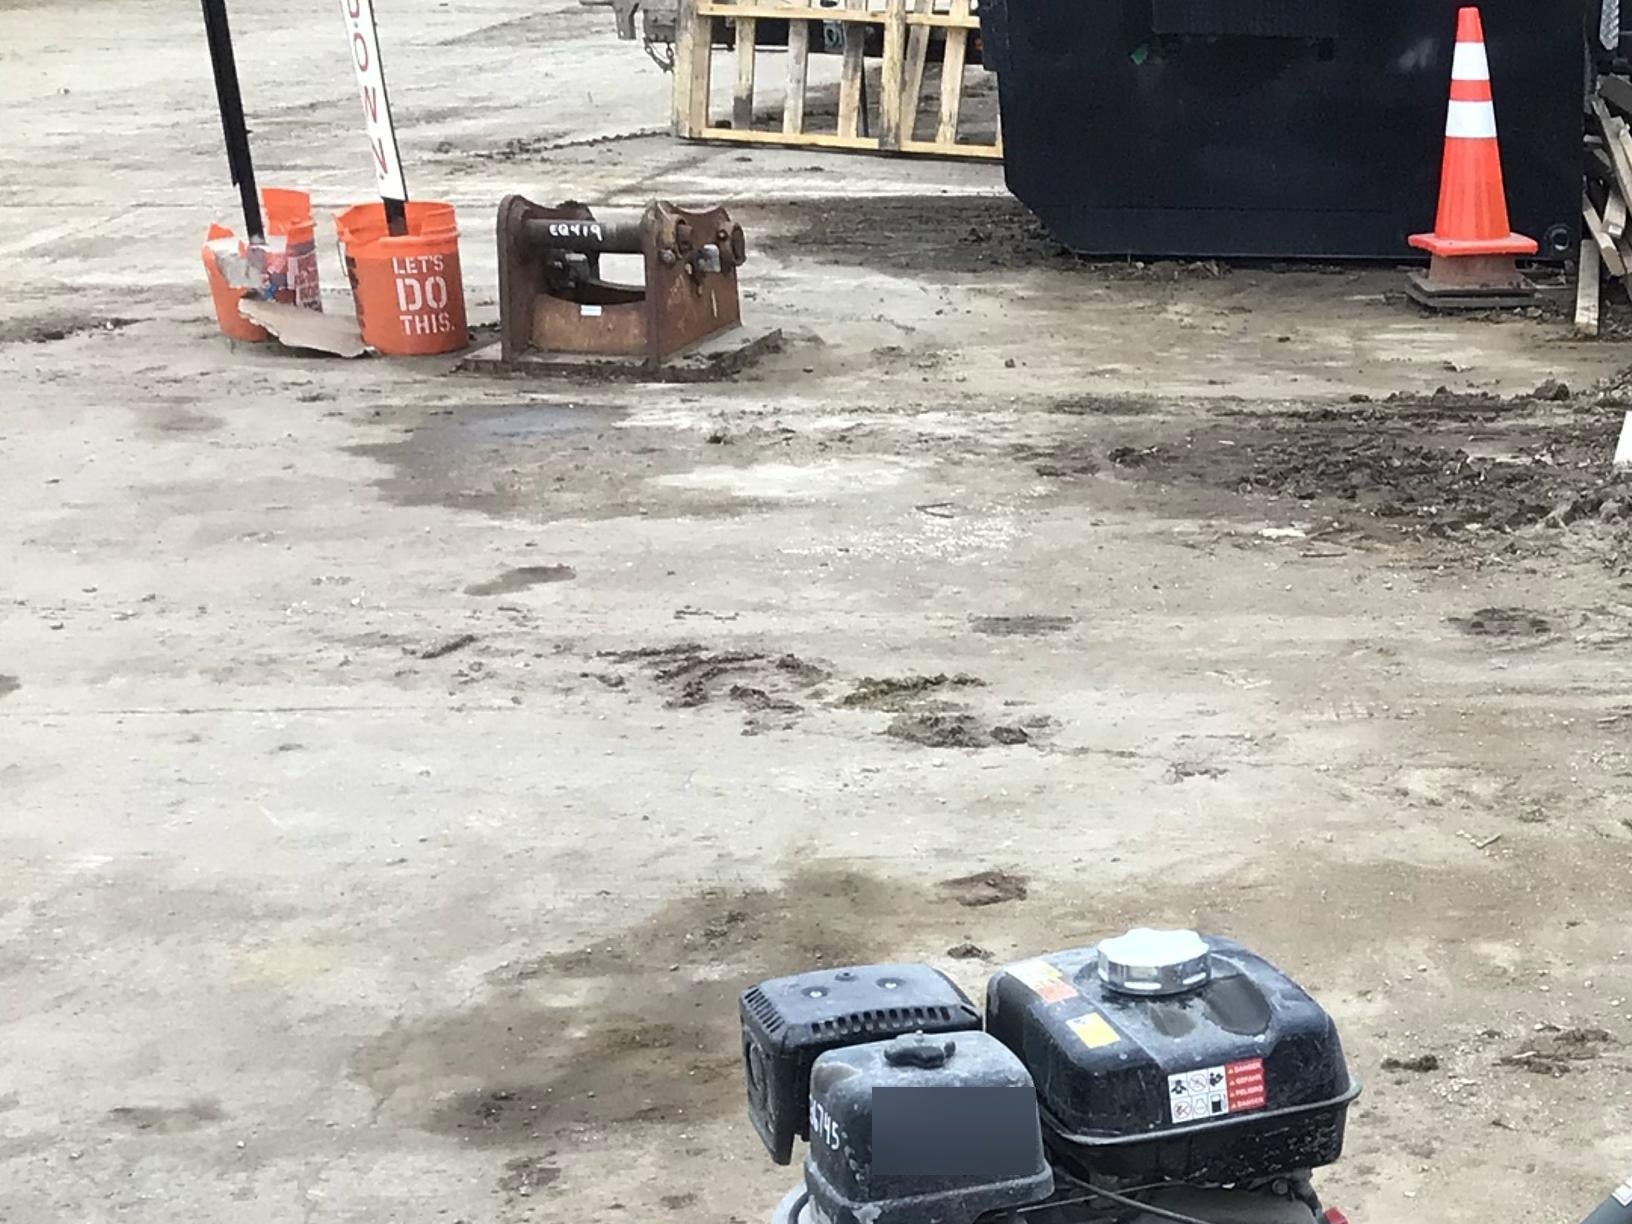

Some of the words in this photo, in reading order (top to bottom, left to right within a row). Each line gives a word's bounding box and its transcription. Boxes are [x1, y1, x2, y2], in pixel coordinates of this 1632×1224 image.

[392, 255, 444, 274] LET'S
[396, 276, 447, 312] DO
[399, 312, 455, 336] THIS.
